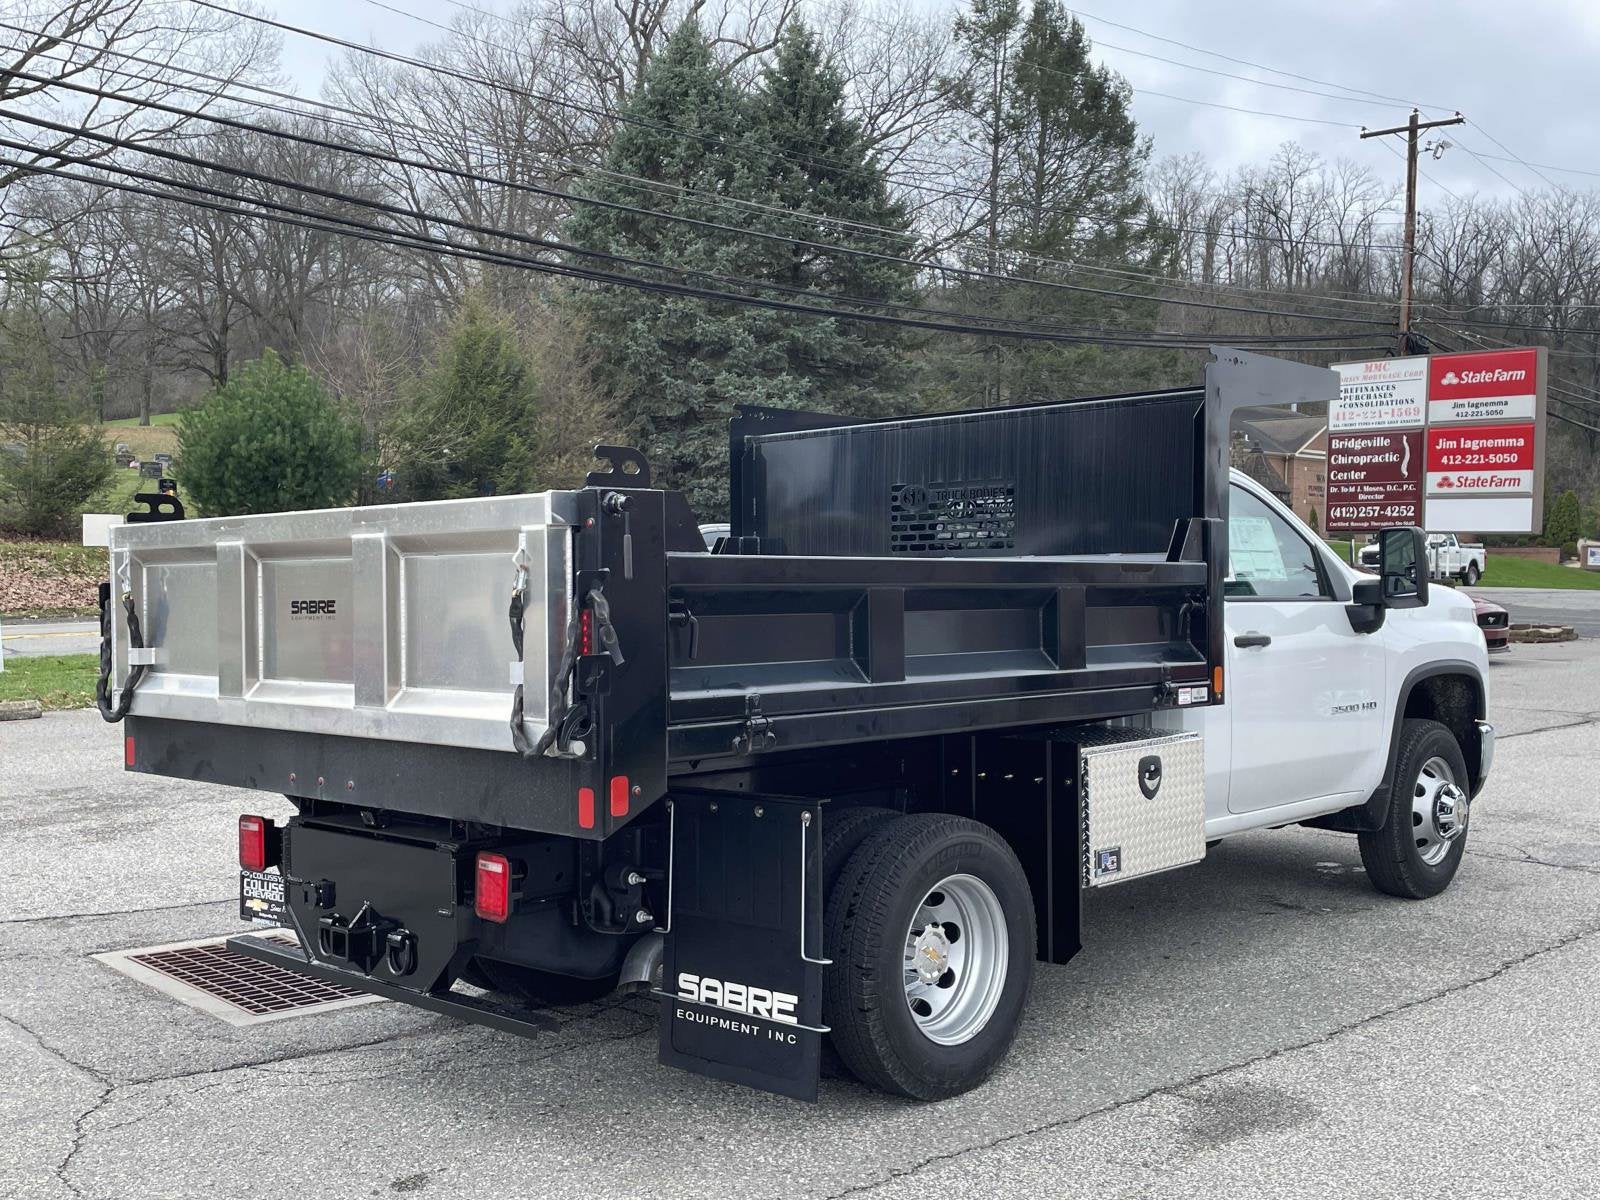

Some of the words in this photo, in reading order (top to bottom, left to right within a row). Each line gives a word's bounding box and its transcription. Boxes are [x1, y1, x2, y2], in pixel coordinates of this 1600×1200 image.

[1343, 392, 1393, 402] PURCHASES
[1343, 398, 1415, 409] CONSOLIDATIONS
[1455, 409, 1504, 418] 412-221-5050
[1331, 437, 1391, 450] Bridgeville
[1435, 438, 1457, 450] Jim
[1330, 452, 1400, 465] Chiropractic
[1441, 453, 1518, 465] 412-221-5050
[1330, 470, 1367, 480] Center
[936, 489, 967, 501] TRUCK
[969, 487, 1005, 499] BODIES
[1330, 506, 1358, 519] (412)
[1358, 505, 1415, 517] 257-4252
[291, 599, 336, 615] SABRE
[1361, 701, 1377, 711] HD
[244, 878, 284, 894] COLUSS
[678, 972, 799, 1024] SABRE
[676, 1008, 760, 1036] EQUIPMENT
[768, 1029, 797, 1044] INC
